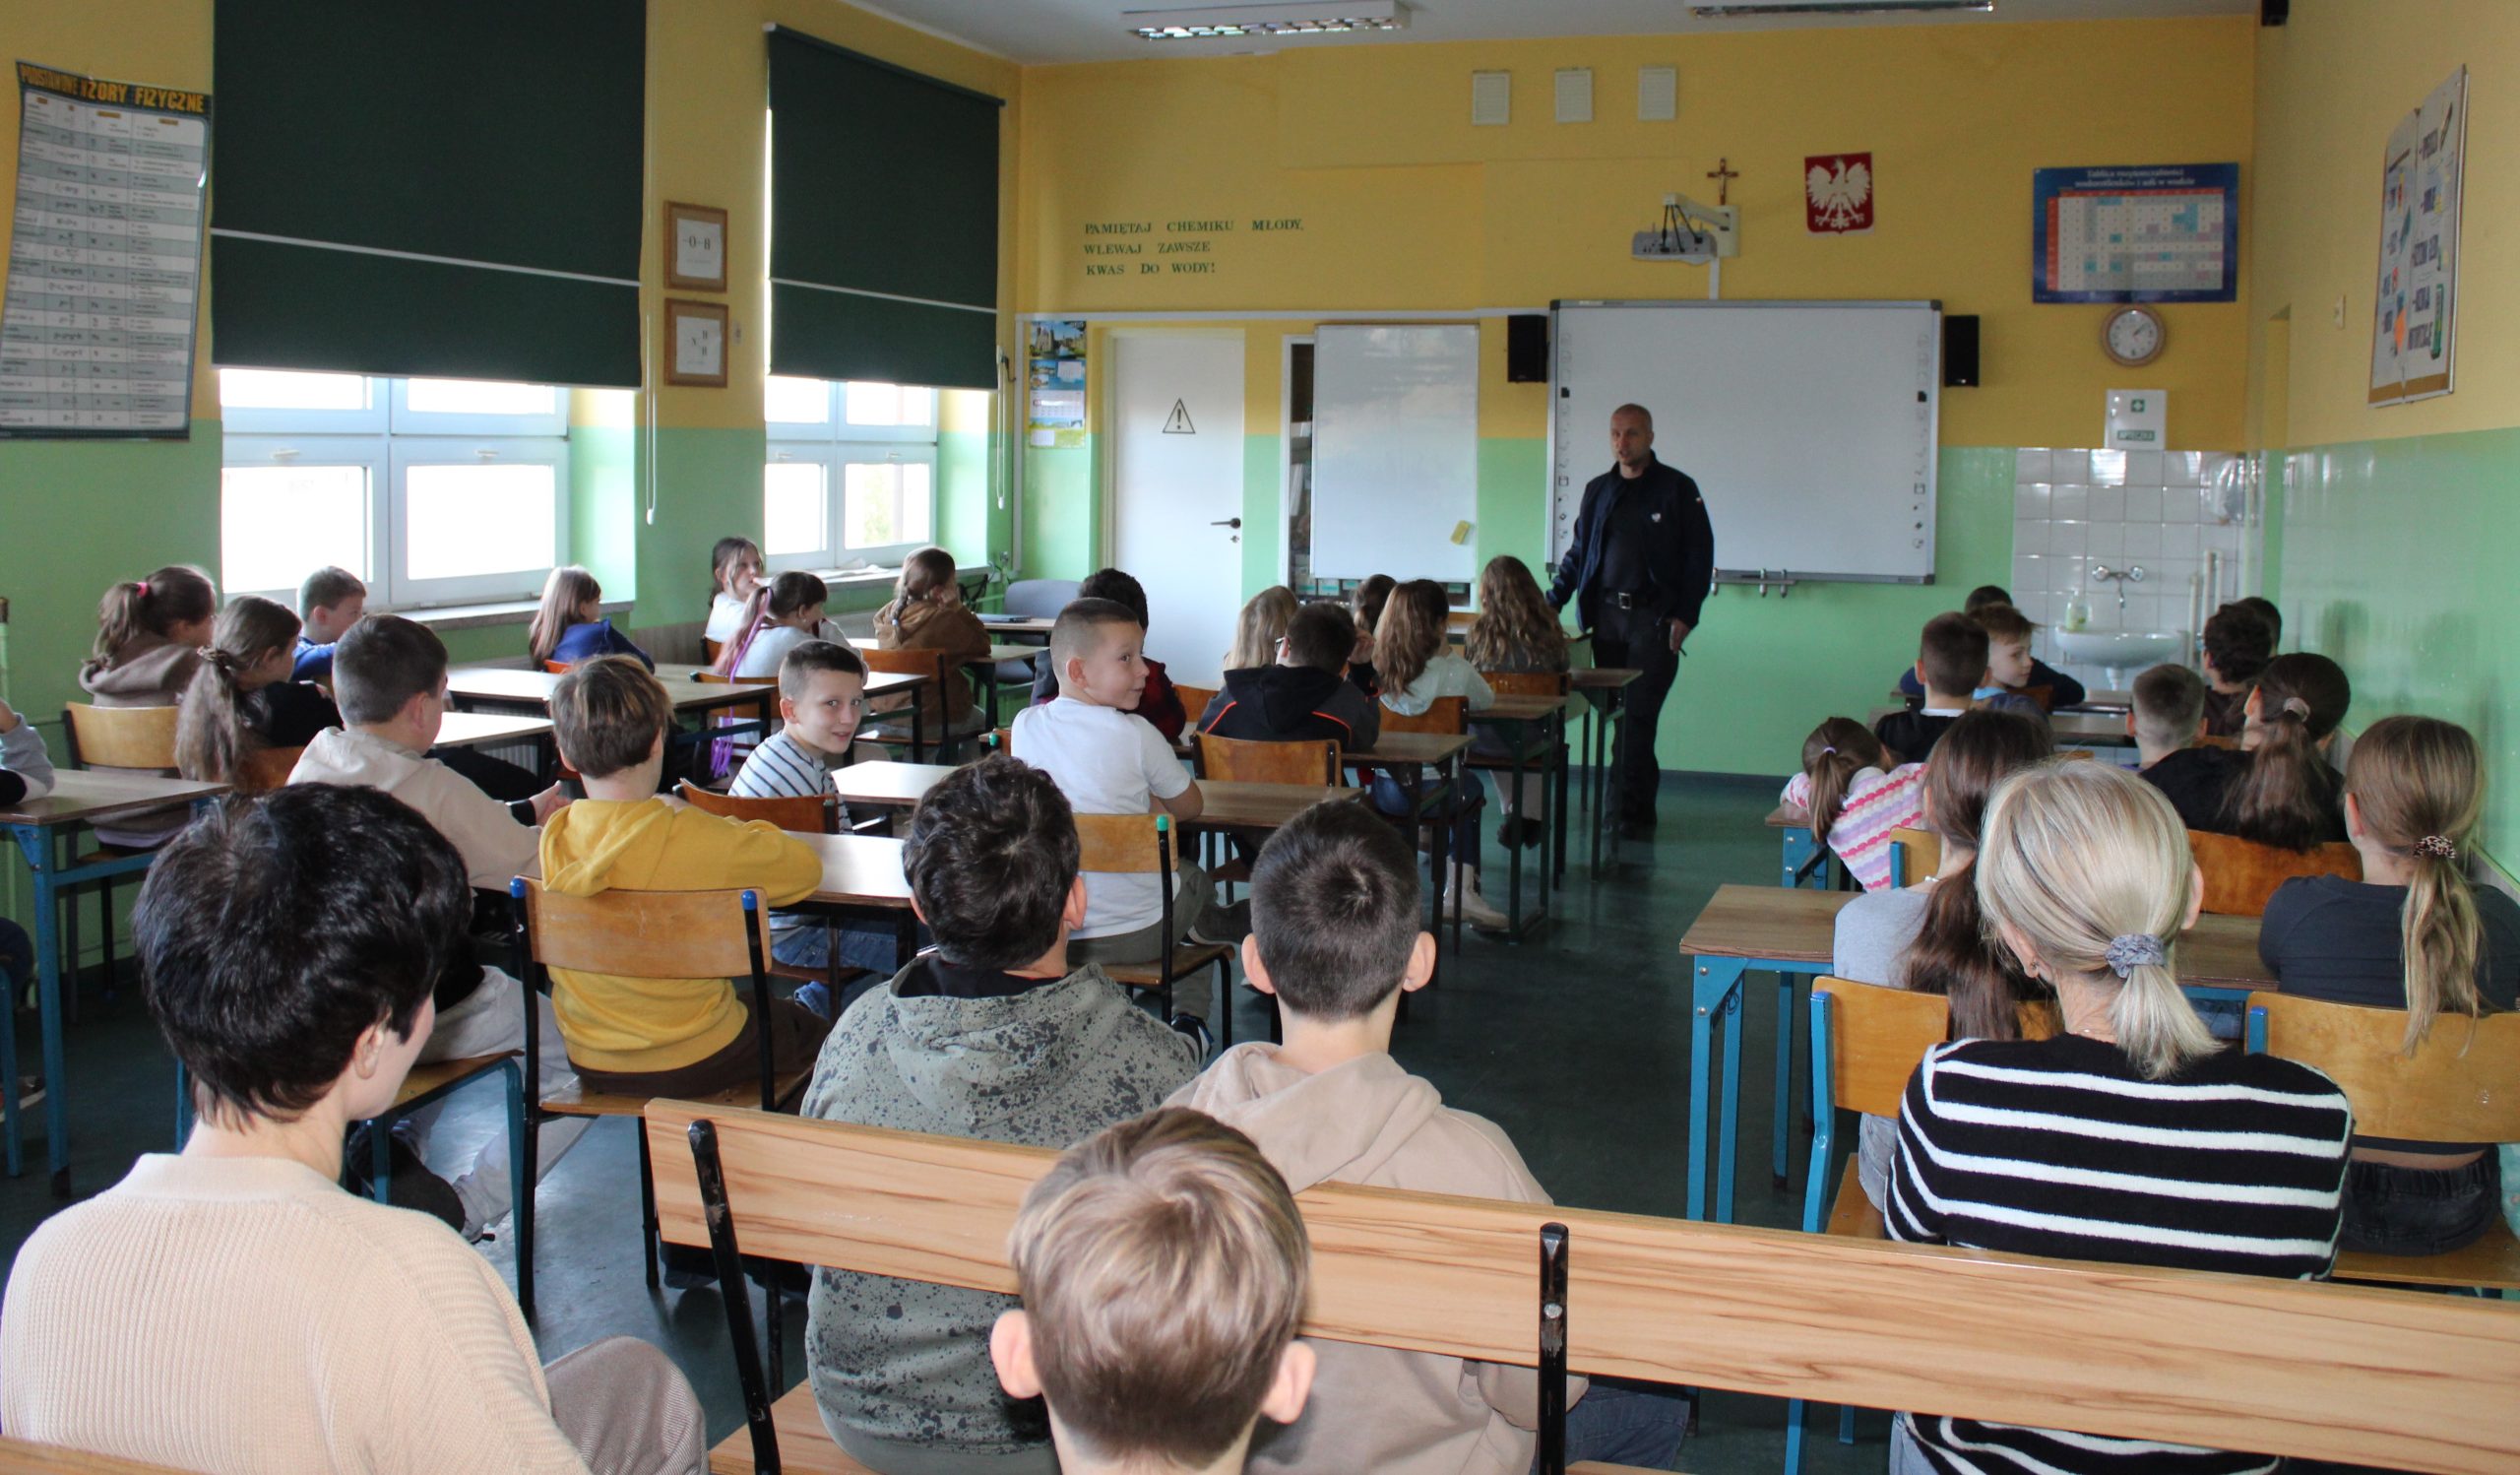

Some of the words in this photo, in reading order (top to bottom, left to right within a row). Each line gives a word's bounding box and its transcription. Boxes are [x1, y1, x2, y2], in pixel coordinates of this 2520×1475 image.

[134, 86, 205, 113] FIZYCZNE
[1085, 223, 1152, 235] PAMIĘTAJ
[1166, 220, 1234, 232] CHEMIKU
[1083, 243, 1142, 255] WLEWAJ
[1157, 241, 1211, 254] ZAWSZE
[1086, 264, 1125, 276] KWAS
[1140, 263, 1161, 275] DO
[1171, 262, 1216, 274] WODY!
